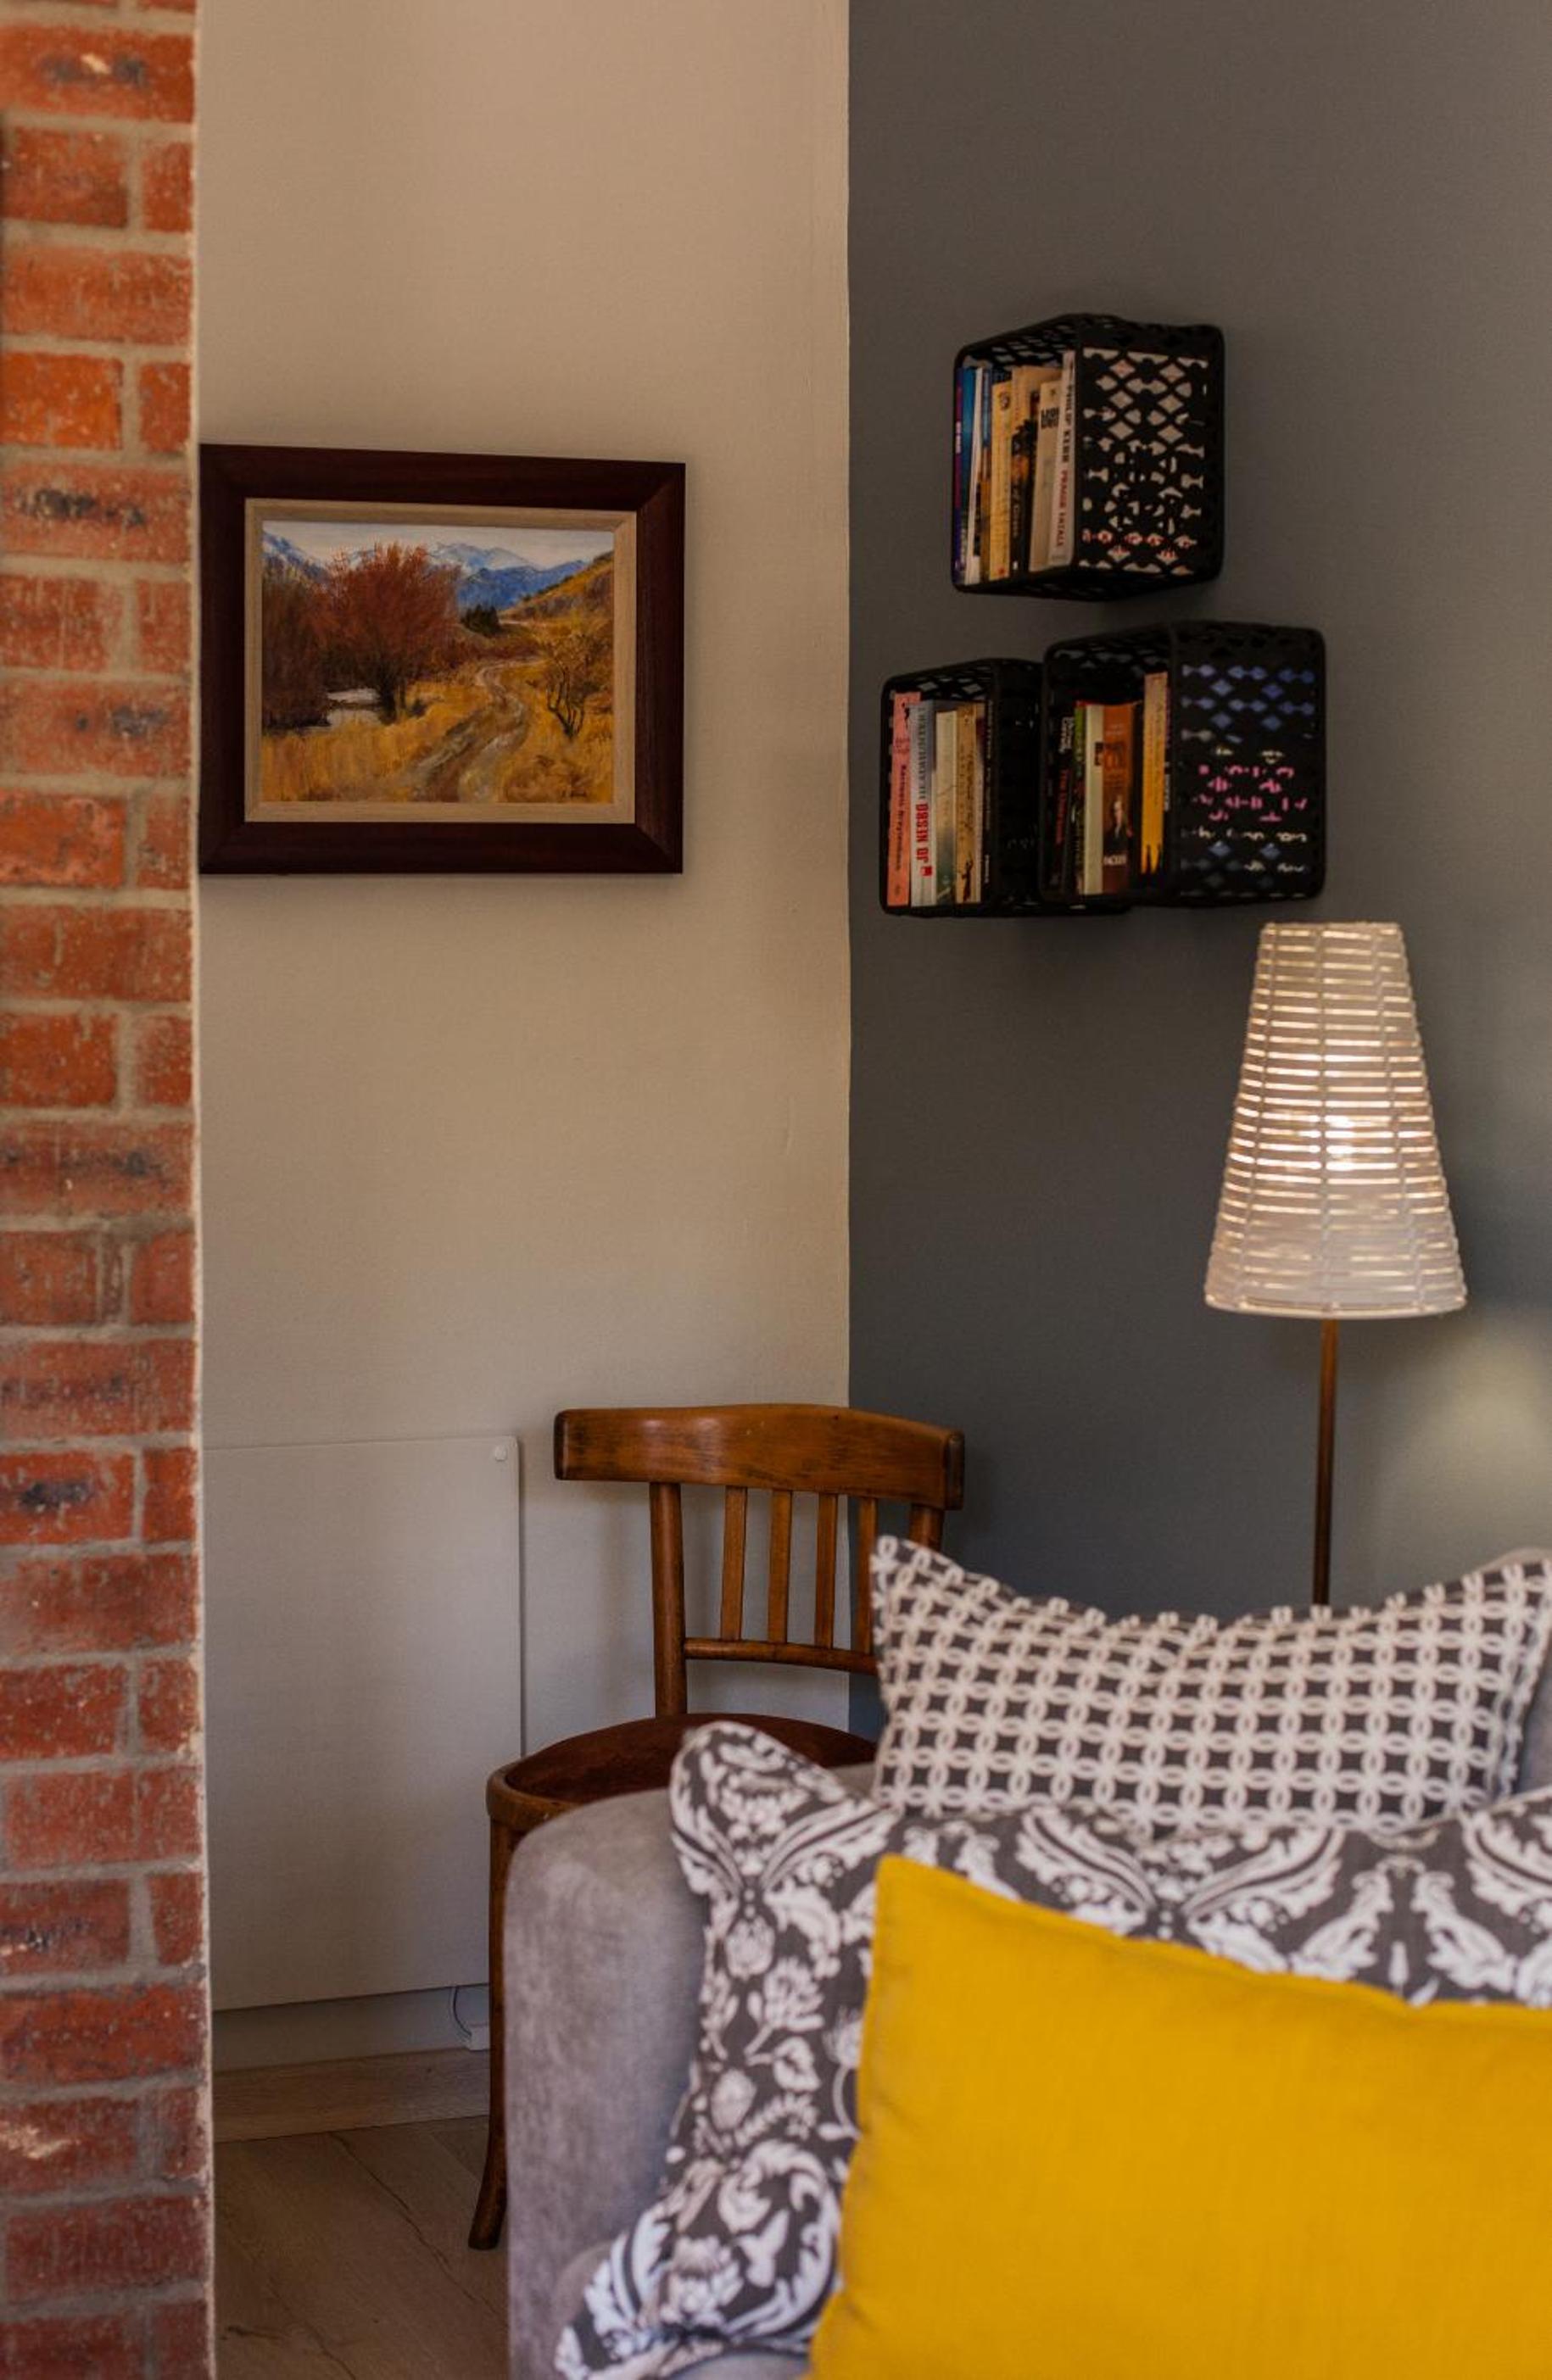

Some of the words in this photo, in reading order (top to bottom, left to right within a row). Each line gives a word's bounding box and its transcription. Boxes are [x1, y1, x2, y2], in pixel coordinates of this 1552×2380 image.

[1059, 470, 1069, 509] PRAGUE
[1057, 512, 1066, 547] FATALE
[916, 847, 929, 863] JO
